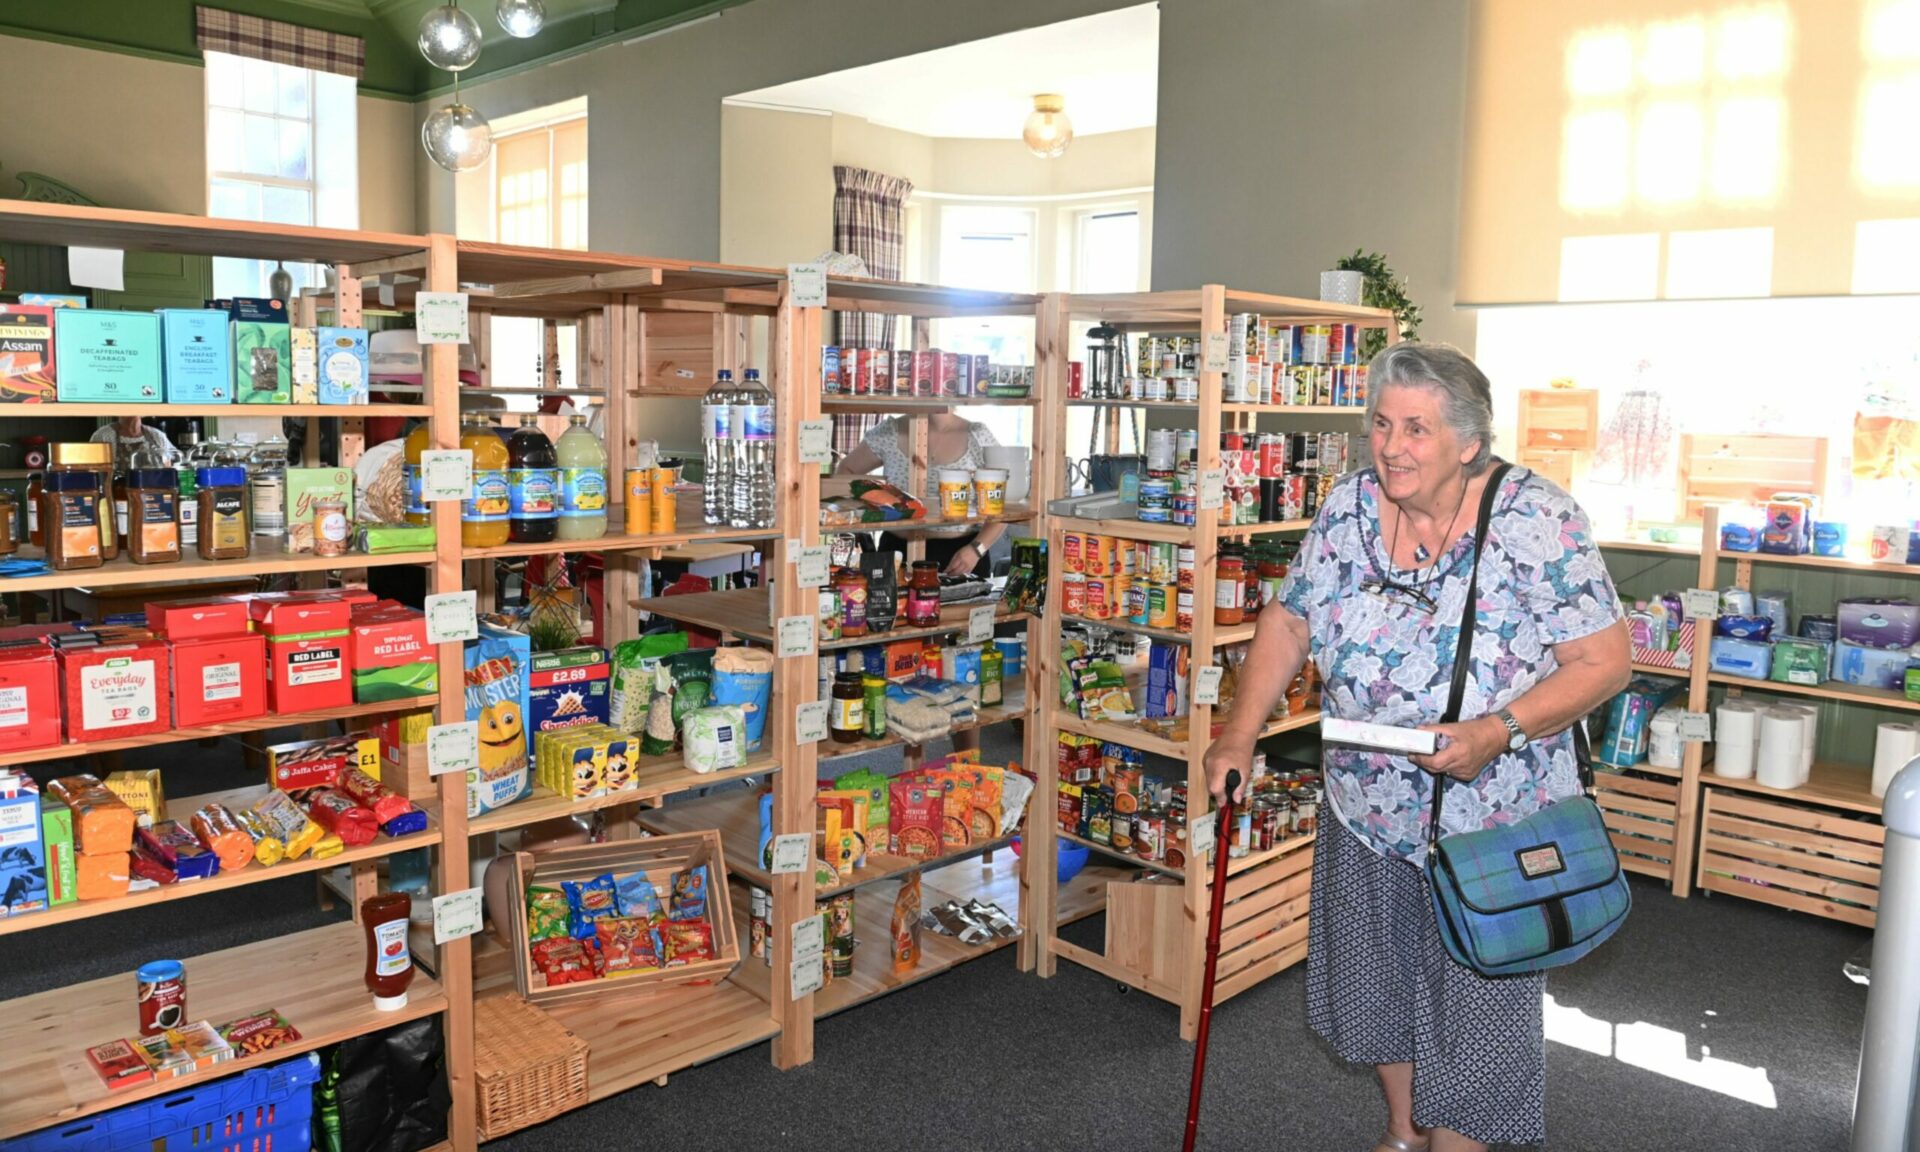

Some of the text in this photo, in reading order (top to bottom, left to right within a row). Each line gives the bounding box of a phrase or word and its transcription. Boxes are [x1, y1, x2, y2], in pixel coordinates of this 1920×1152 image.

[2, 340, 43, 352] Assam
[80, 348, 138, 356] DECAFFEINATED
[374, 641, 421, 655] RED LABEL
[293, 650, 334, 662] RED LABEL
[90, 672, 146, 690] Everyday
[552, 669, 587, 683] £2.69
[361, 754, 376, 765] £1
[291, 763, 337, 776] Jaffa Cakes
[491, 774, 520, 792] WHEAT
[493, 786, 518, 801] PUFFS
